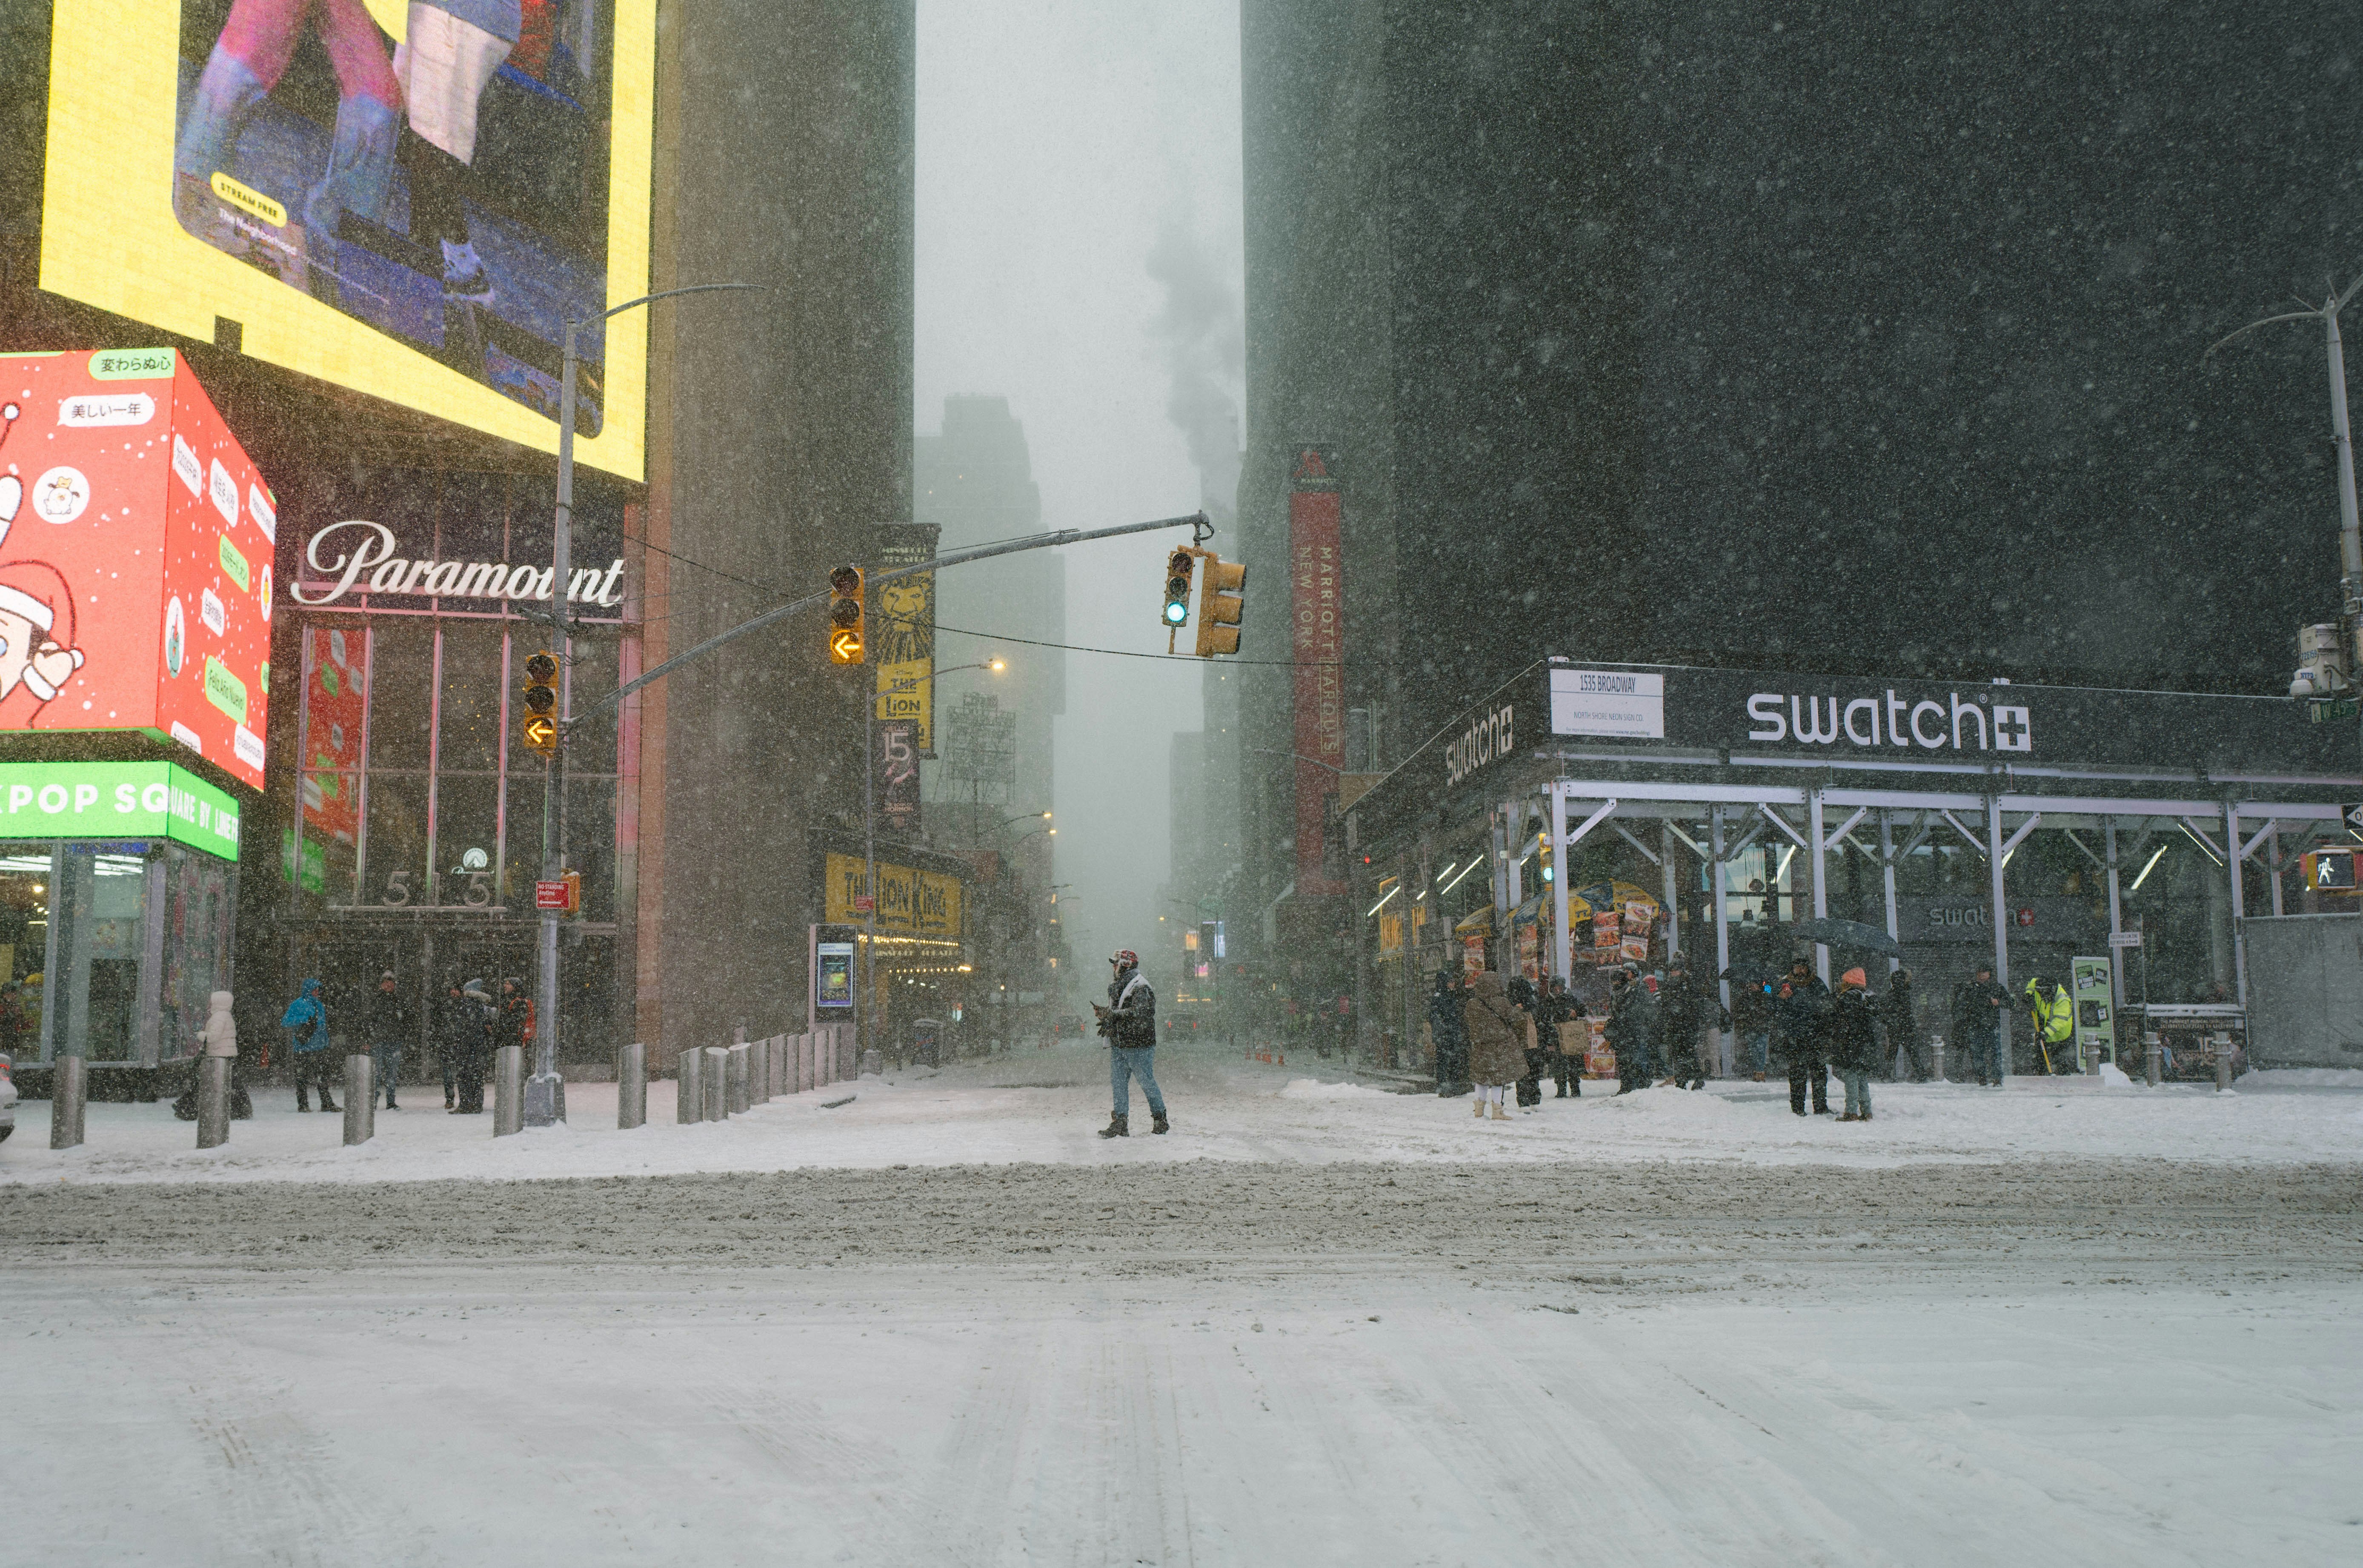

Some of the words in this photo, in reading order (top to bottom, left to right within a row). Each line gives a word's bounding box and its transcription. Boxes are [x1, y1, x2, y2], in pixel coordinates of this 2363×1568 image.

[221, 182, 256, 206] STREAM
[258, 201, 277, 218] FREE
[101, 357, 170, 372] 変わらぬ心
[71, 403, 141, 418] 美しい一年
[290, 520, 624, 608] Paramount
[1300, 547, 1314, 588] NEW
[1321, 547, 1334, 650] MARRIOTT
[1301, 598, 1314, 650] YORK
[891, 678, 917, 690] THE
[1580, 674, 1596, 691] 1535
[1597, 675, 1636, 693] BROADWAY
[1323, 661, 1338, 750] MARQUIS
[1574, 711, 1591, 719] NORTH
[1592, 712, 1608, 720] SHORE
[1747, 689, 1987, 750] swatch
[2322, 704, 2332, 718] W
[882, 732, 910, 761] 15
[1446, 706, 1499, 787] swatch
[0, 784, 99, 814] POP
[199, 799, 212, 830] BY
[913, 872, 946, 929] KING
